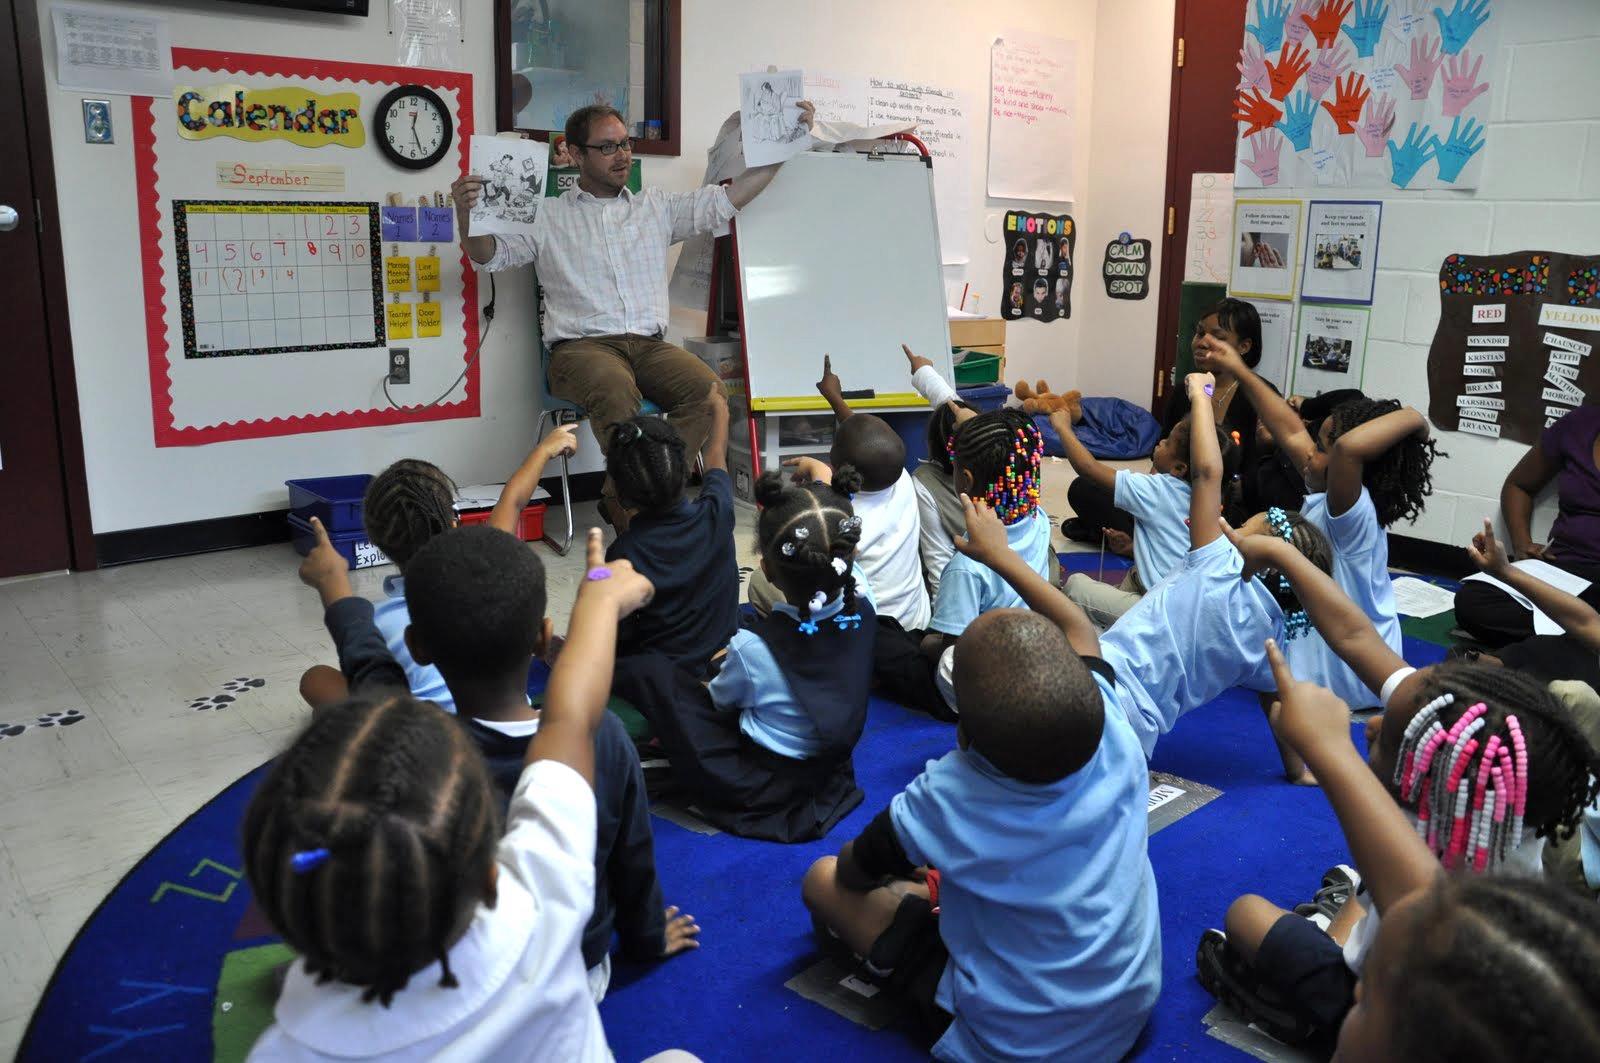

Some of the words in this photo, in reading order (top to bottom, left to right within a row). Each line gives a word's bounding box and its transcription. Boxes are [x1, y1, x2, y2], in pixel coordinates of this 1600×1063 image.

[399, 101, 406, 109] 11
[410, 97, 418, 106] 12
[424, 102, 428, 111] 1
[178, 91, 357, 135] Calendar
[390, 109, 398, 118] 10
[431, 112, 438, 121] 2
[385, 121, 391, 131] 9
[435, 125, 441, 134] 3
[389, 135, 395, 144] 8
[431, 139, 437, 147] 4
[399, 145, 404, 154] 7
[410, 149, 416, 158] 6
[423, 147, 428, 156] 5
[230, 164, 310, 187] September
[424, 210, 451, 223] Names
[325, 215, 338, 236] 2
[349, 215, 361, 235] 3
[431, 223, 440, 236] 2
[1007, 214, 1073, 235] EMOTIONS
[195, 243, 208, 263] 4
[225, 243, 237, 261] 5
[250, 242, 263, 261] 6
[273, 241, 286, 257] 7
[328, 243, 342, 264] 9
[351, 243, 366, 260] 10
[1110, 244, 1143, 257] CALM
[1106, 263, 1145, 275] DOWN
[1110, 281, 1143, 293] SPOT
[418, 309, 435, 317] Door
[1477, 309, 1502, 319] RED
[1545, 310, 1600, 325] YELLOW
[1545, 336, 1589, 353] CHAUNCEY
[1552, 352, 1579, 360] KEITH
[1466, 384, 1500, 392] BREANA
[1544, 391, 1580, 403] MORGAN
[1459, 399, 1504, 408] MARSHAYLA
[1460, 410, 1496, 419] DEONNAH
[1462, 422, 1498, 433] ARYANNA
[355, 549, 386, 568] Explo
